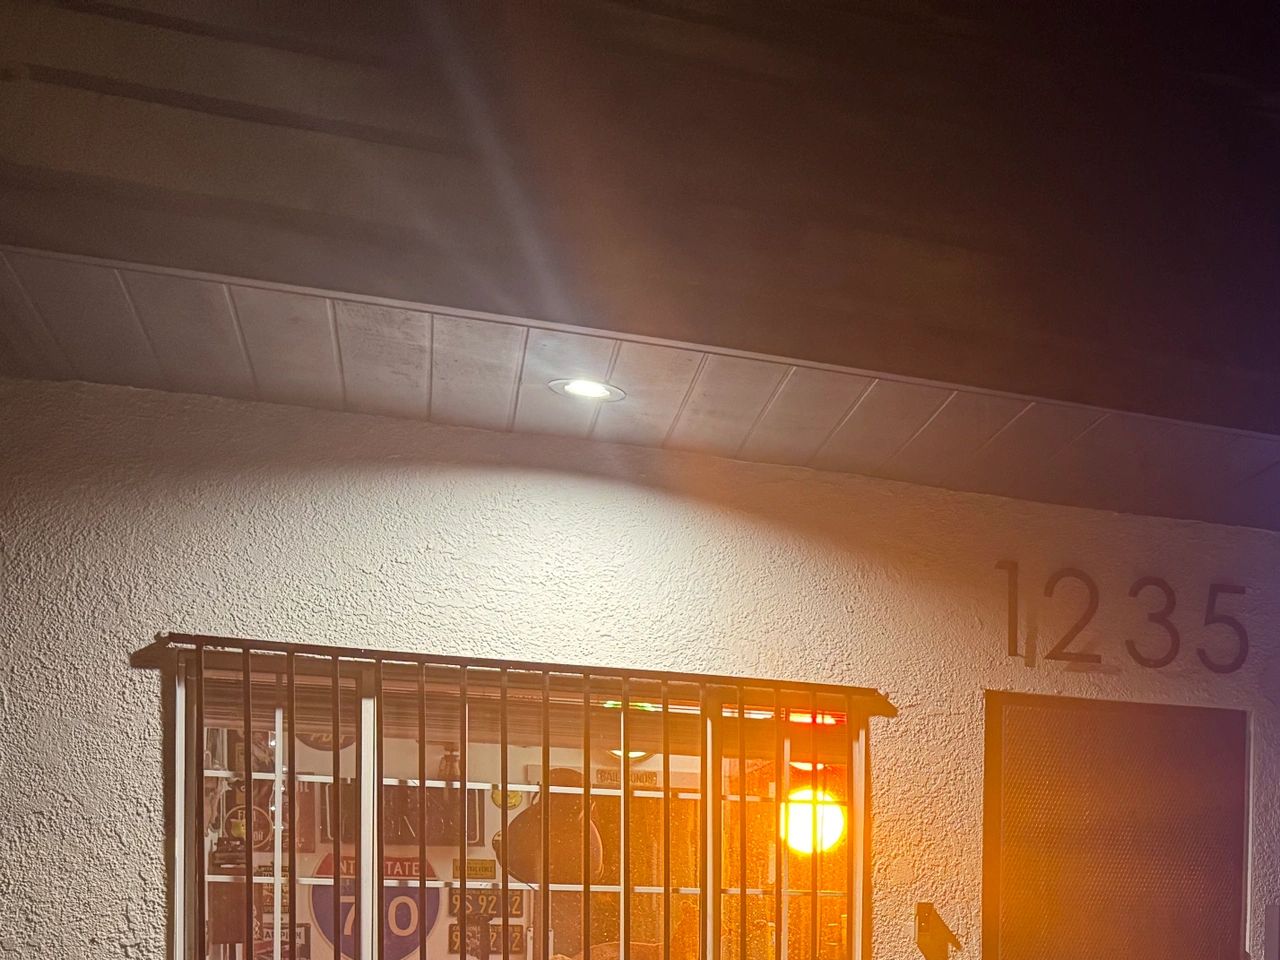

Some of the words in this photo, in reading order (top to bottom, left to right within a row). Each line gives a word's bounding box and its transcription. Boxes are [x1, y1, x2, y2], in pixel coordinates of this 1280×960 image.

[995, 560, 1249, 674] 1235
[334, 860, 421, 876] NTTATE
[338, 895, 419, 937] 70
[478, 895, 521, 915] 922
